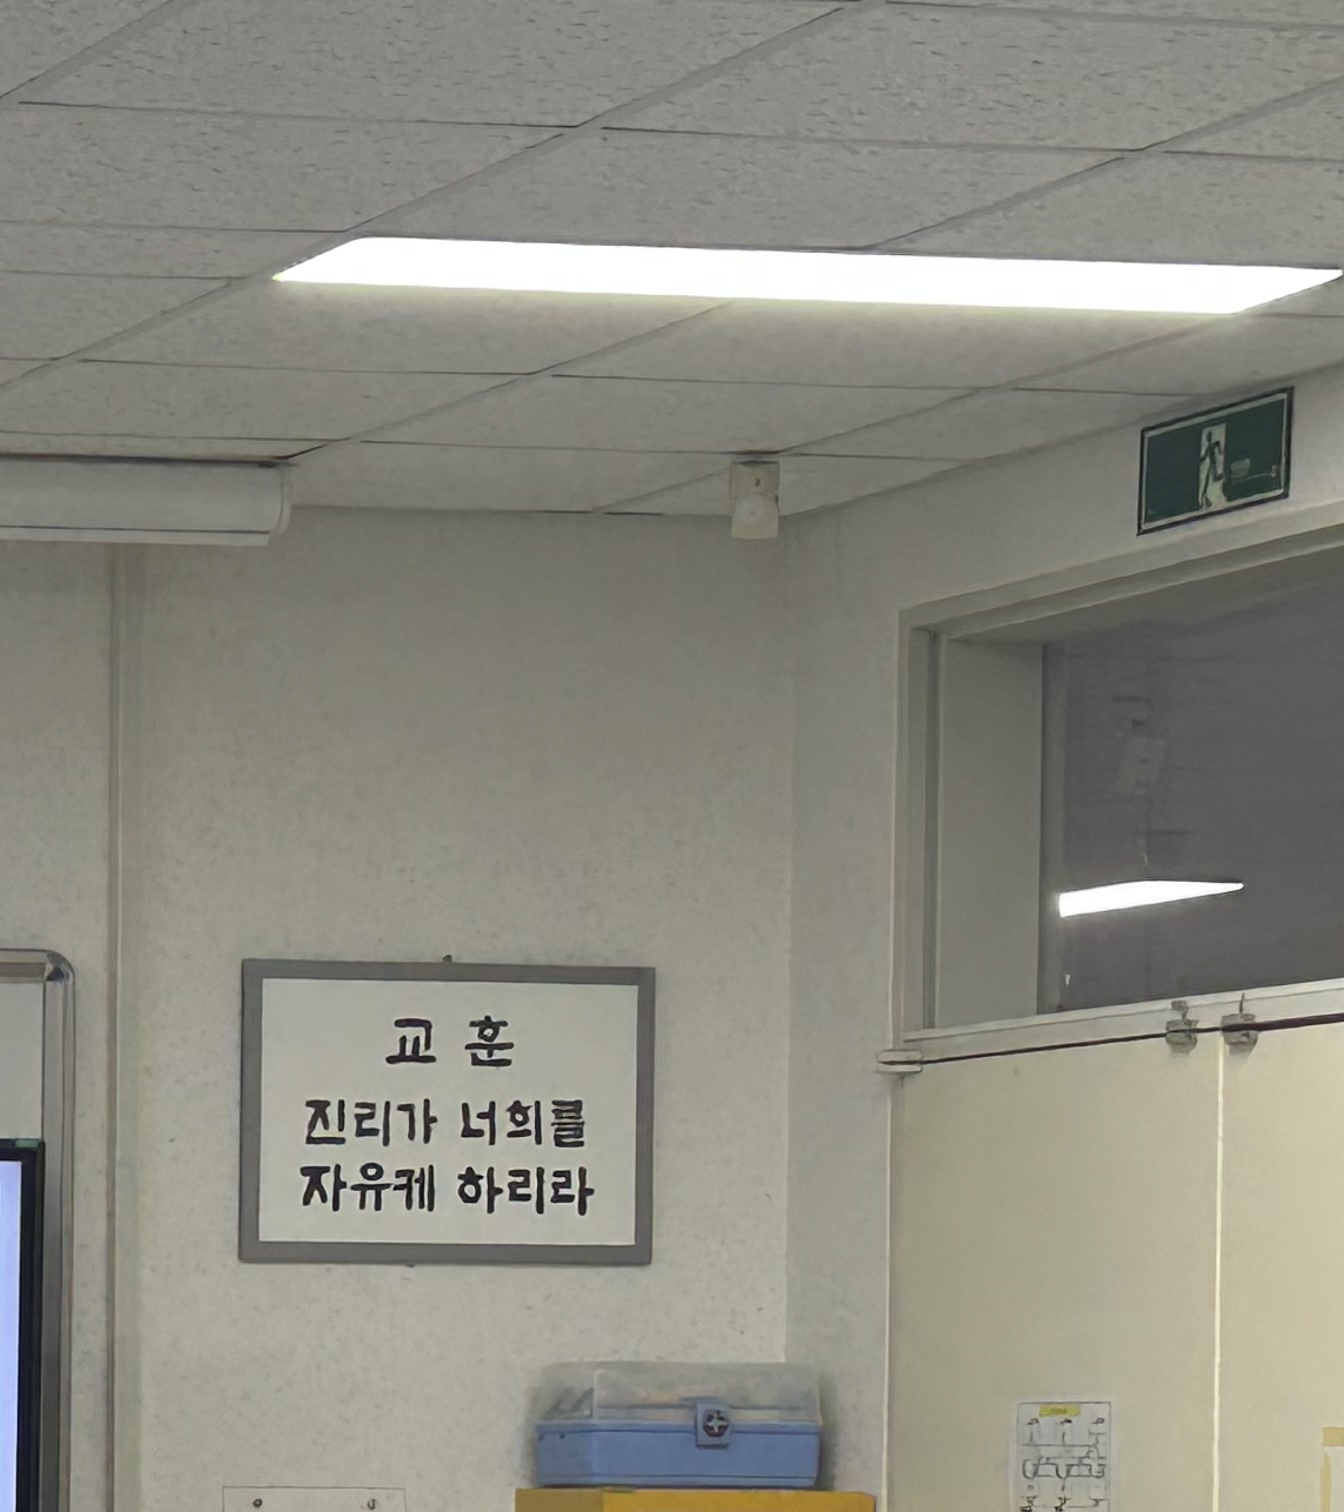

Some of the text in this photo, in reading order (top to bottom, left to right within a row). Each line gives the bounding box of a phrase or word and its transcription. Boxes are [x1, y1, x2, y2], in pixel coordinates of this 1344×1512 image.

[385, 1015, 515, 1067] 교 훈
[304, 1099, 586, 1148] 진리가 너희를
[457, 1166, 594, 1216] 하리라
